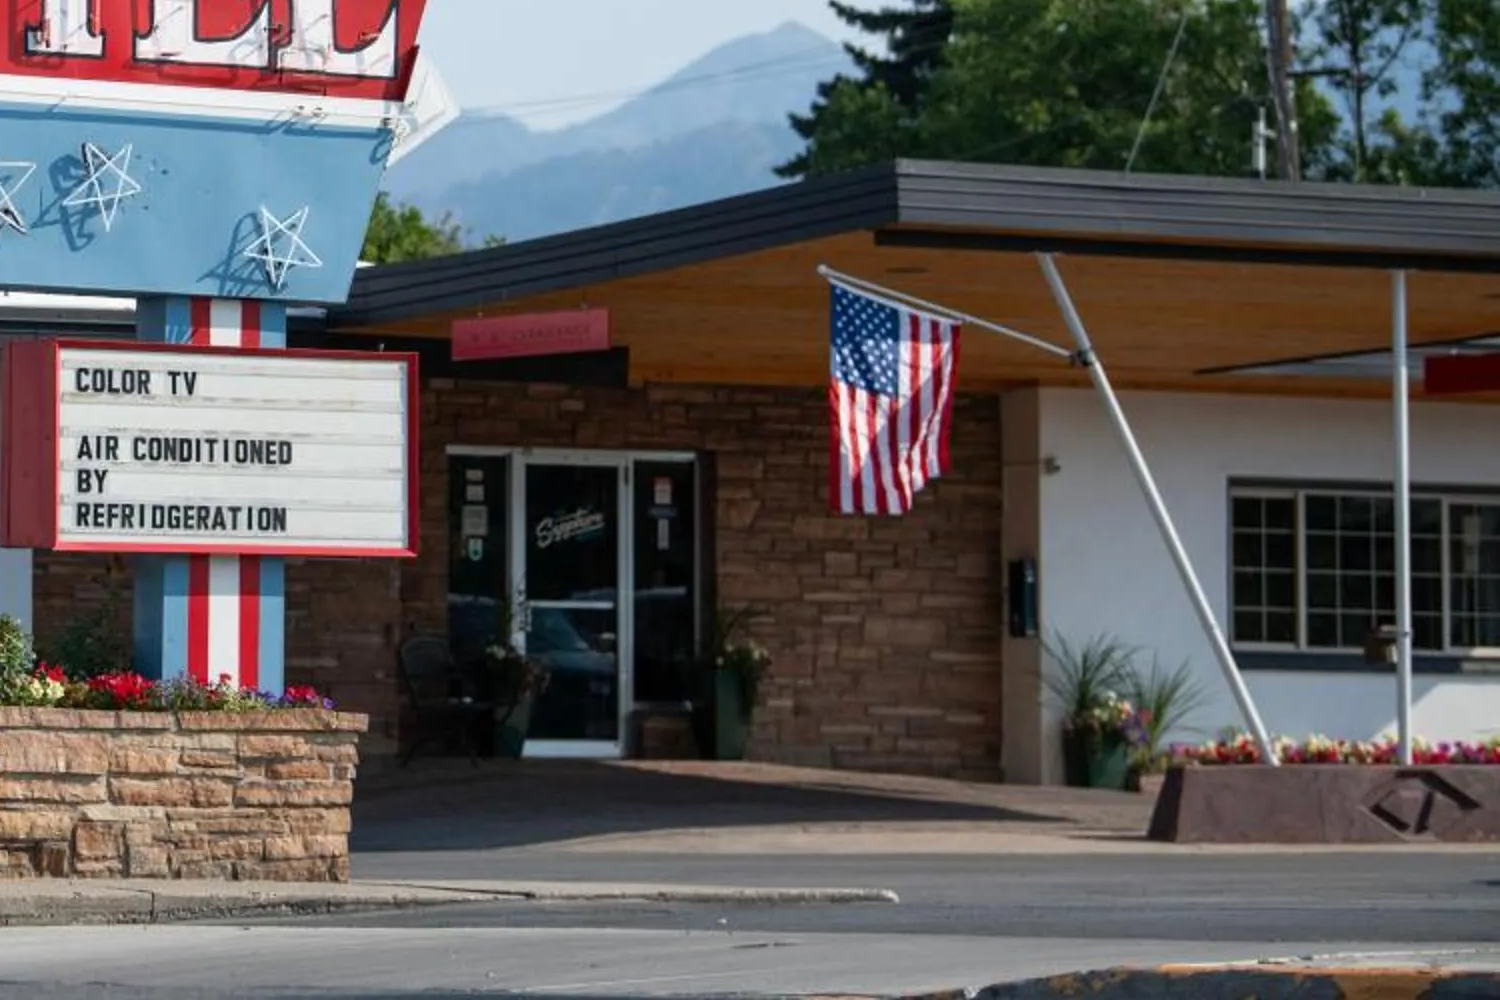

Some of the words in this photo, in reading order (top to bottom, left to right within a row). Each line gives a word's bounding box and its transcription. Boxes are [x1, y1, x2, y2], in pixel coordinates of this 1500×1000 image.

[75, 367, 151, 395] COLOR
[168, 371, 197, 395] TV
[77, 436, 119, 461] AIR
[133, 437, 292, 465] CONDITIONED
[77, 469, 108, 494] BY
[76, 503, 287, 531] REFRIDGERATION
